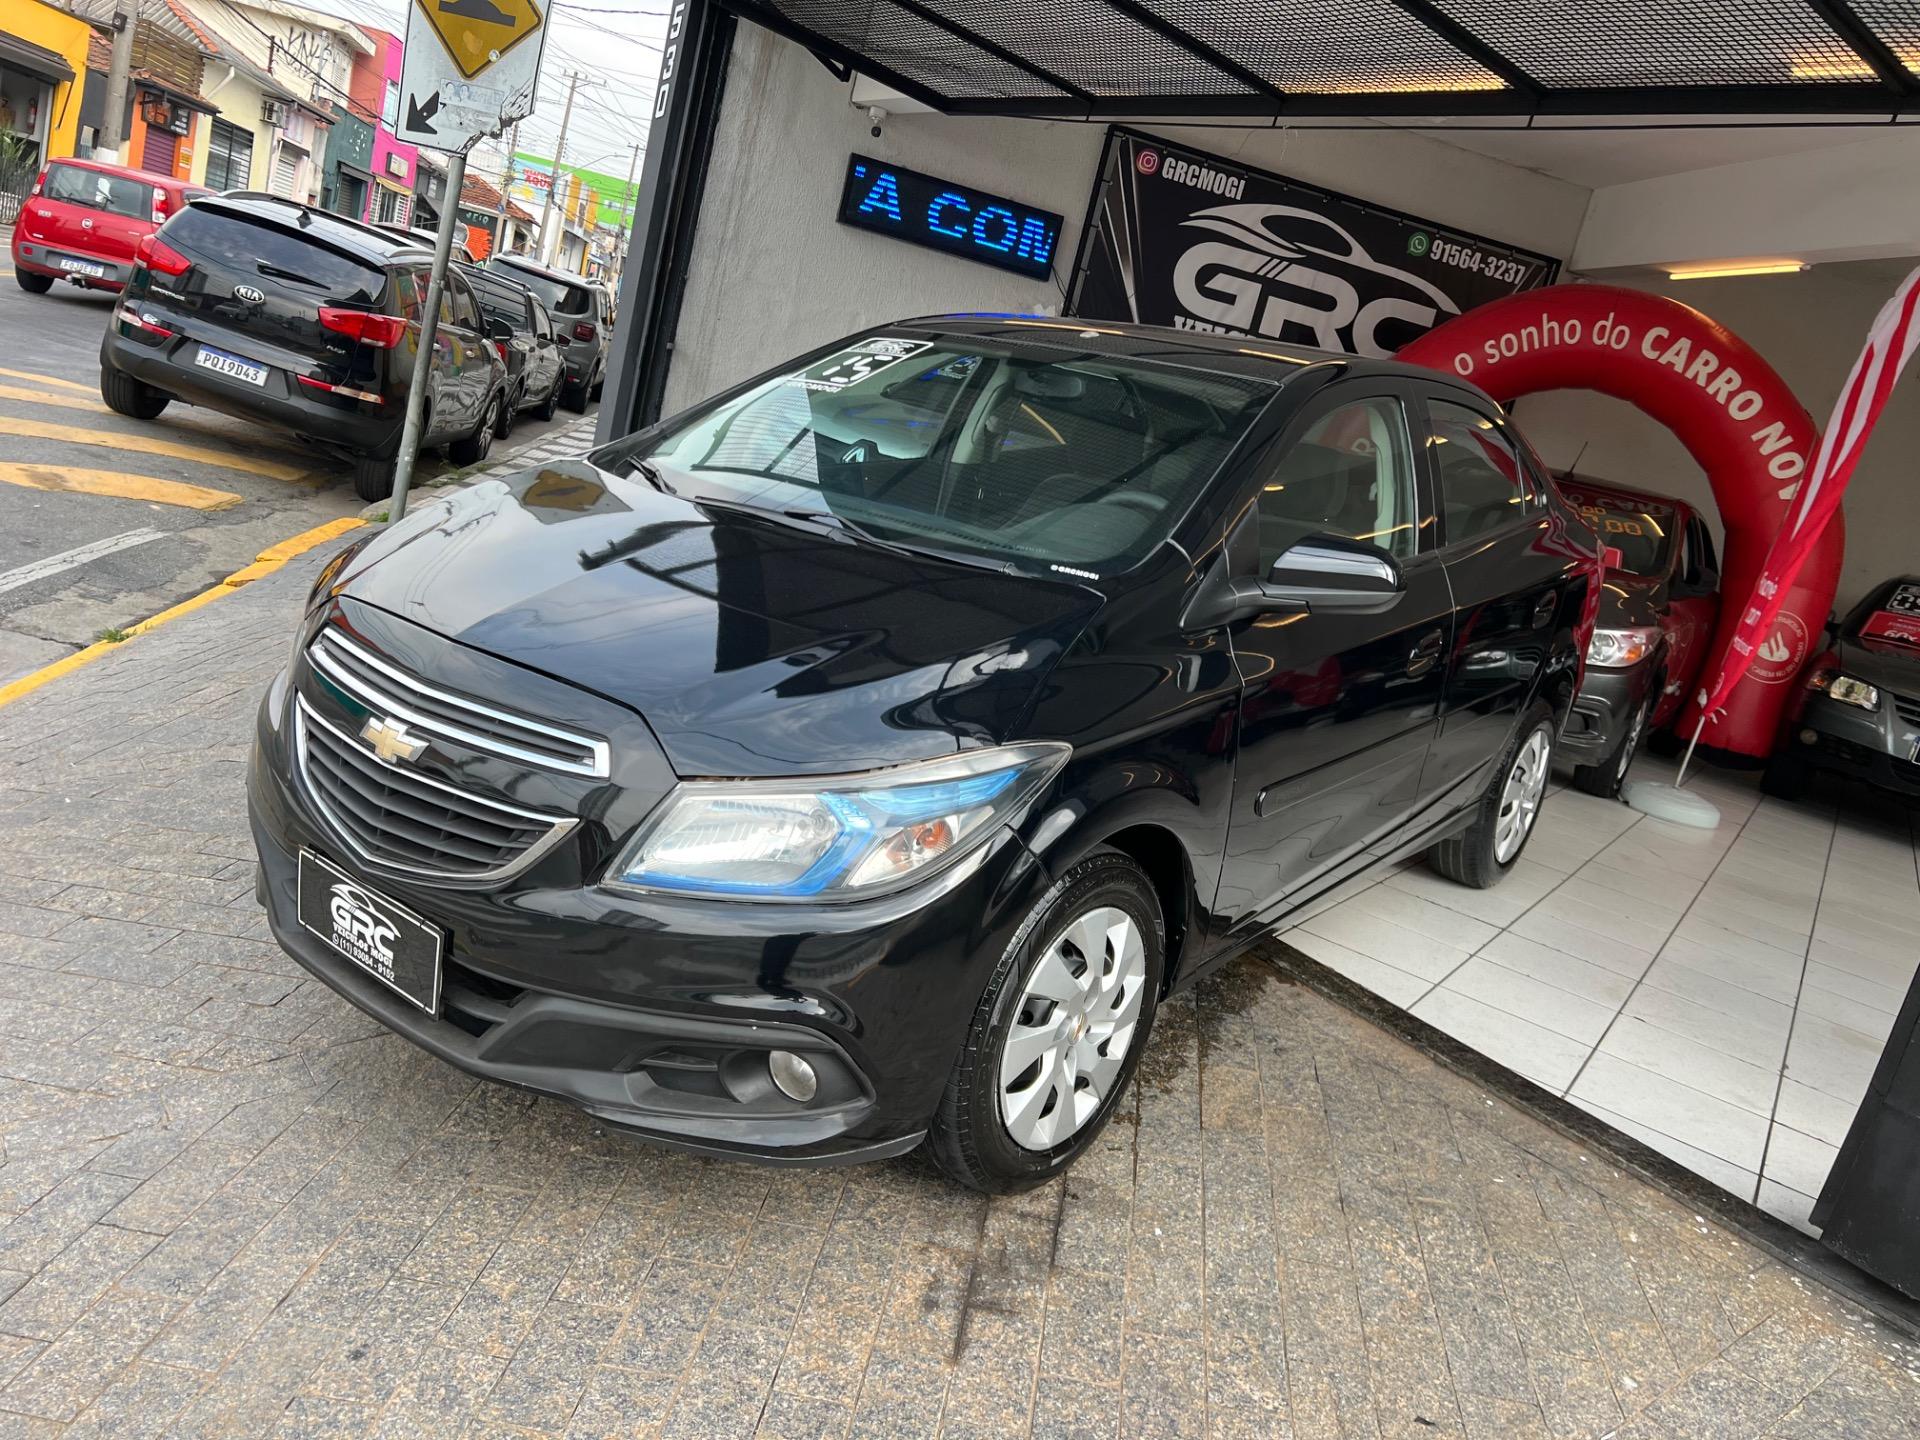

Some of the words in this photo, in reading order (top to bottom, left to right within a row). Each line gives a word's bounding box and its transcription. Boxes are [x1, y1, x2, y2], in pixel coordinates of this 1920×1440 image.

[1162, 157, 1246, 200] GRCMOGI
[1430, 239, 1526, 285] 91564-3237
[238, 286, 260, 301] KIA
[1173, 241, 1437, 360] GRC
[203, 353, 260, 381] PQI9D43
[1454, 352, 1474, 376] o
[1484, 313, 1582, 364] sonho
[1592, 312, 1630, 350] do
[1641, 326, 1763, 421] CARRO
[330, 896, 395, 960] GRC
[332, 921, 369, 952] VEICULOS
[370, 946, 393, 968] MOGI
[339, 937, 353, 955] (11)
